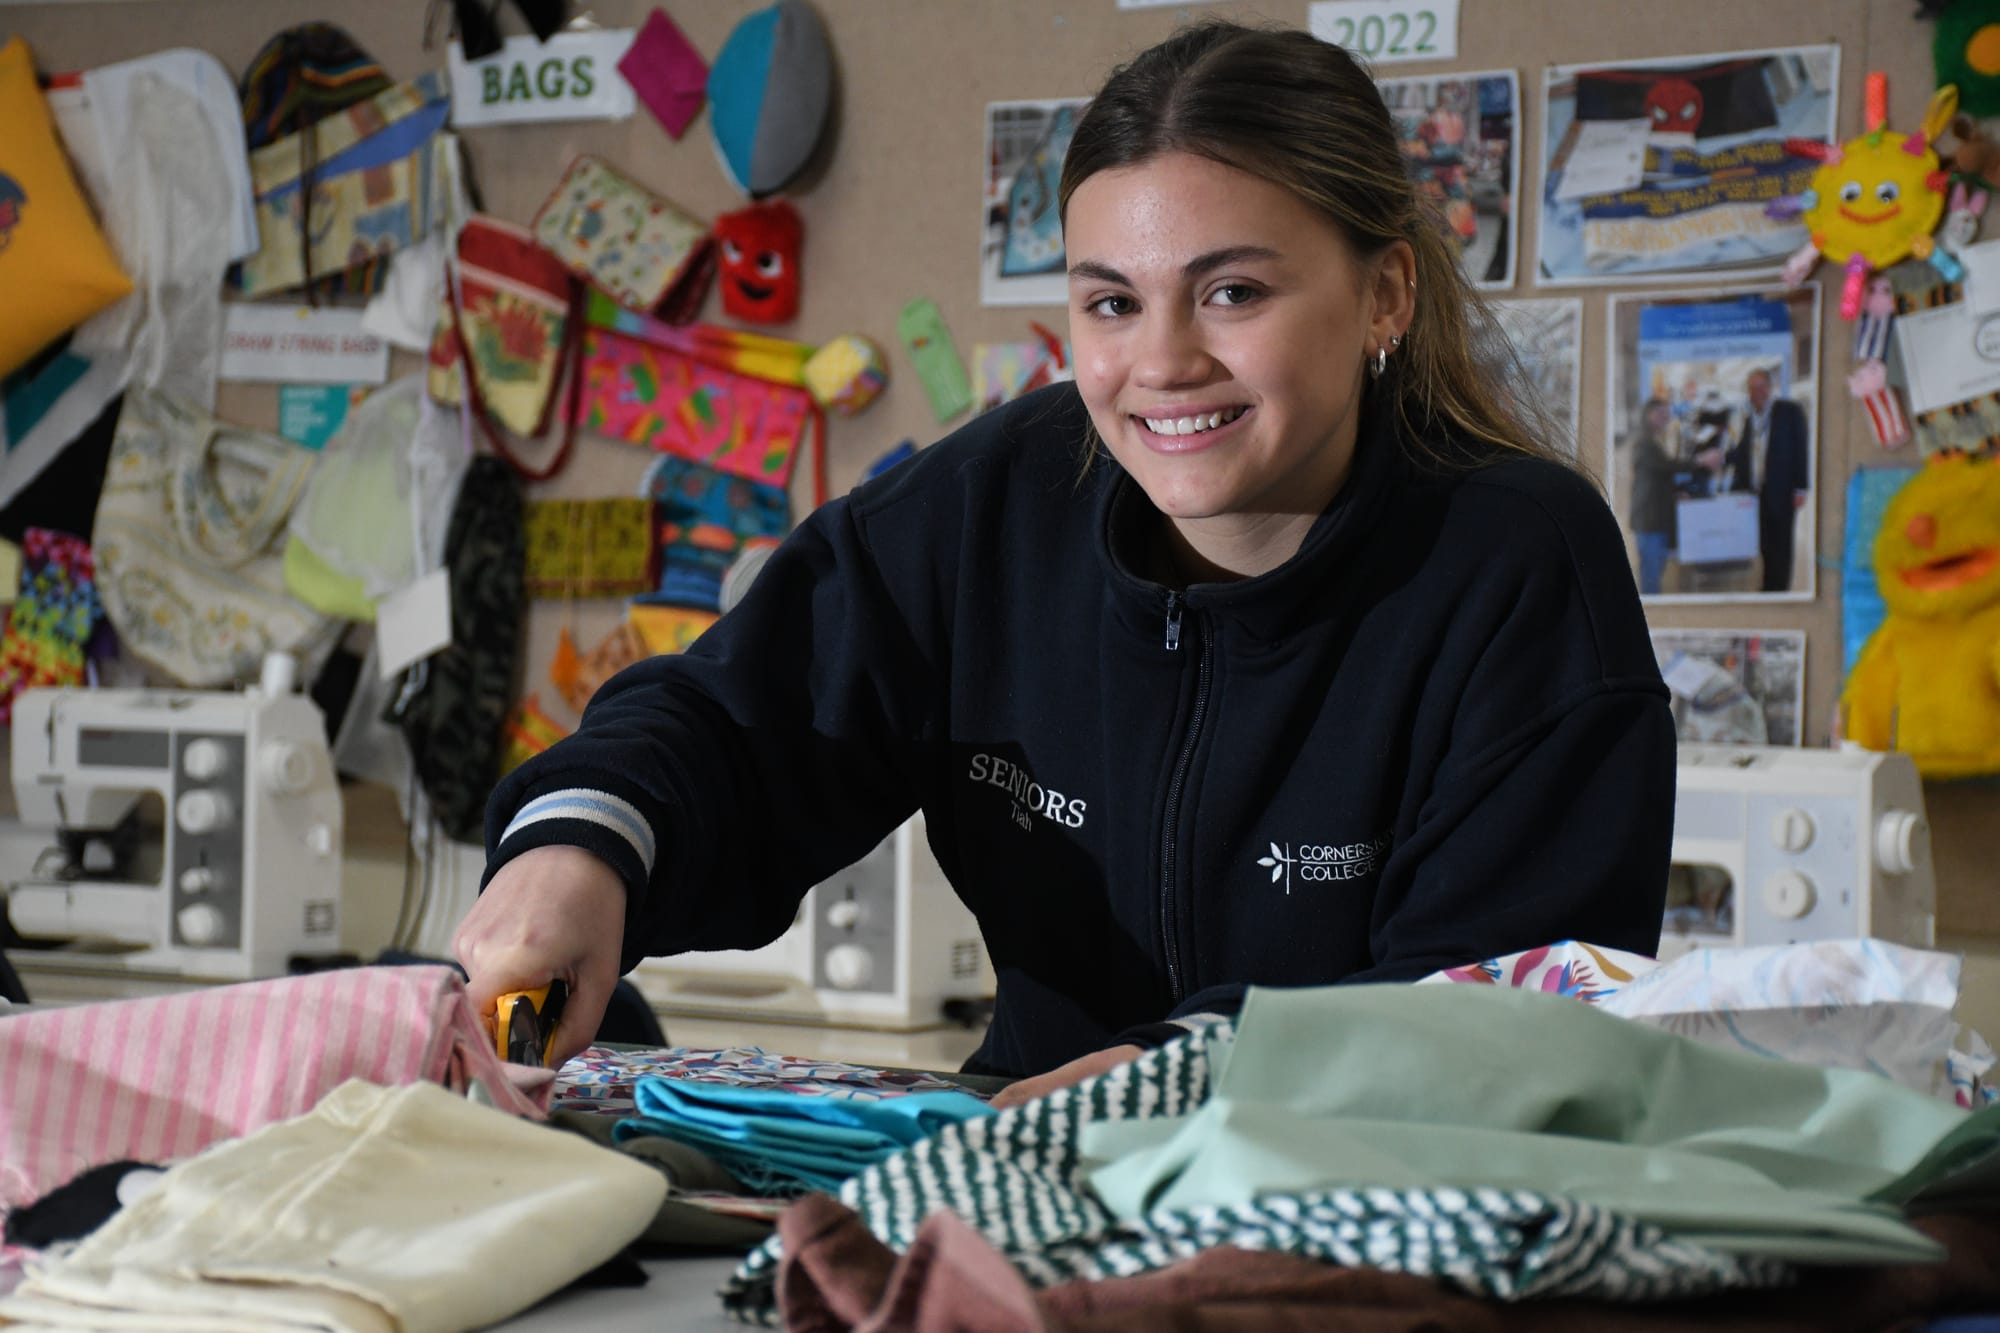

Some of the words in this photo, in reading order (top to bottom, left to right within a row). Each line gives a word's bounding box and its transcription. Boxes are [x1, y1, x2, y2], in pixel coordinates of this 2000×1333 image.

[1334, 10, 1437, 57] 2022
[482, 56, 595, 105] BAGS
[969, 753, 1086, 829] SENIORS
[1010, 801, 1032, 833] Tiah
[1300, 858, 1376, 881] COLLEGE
